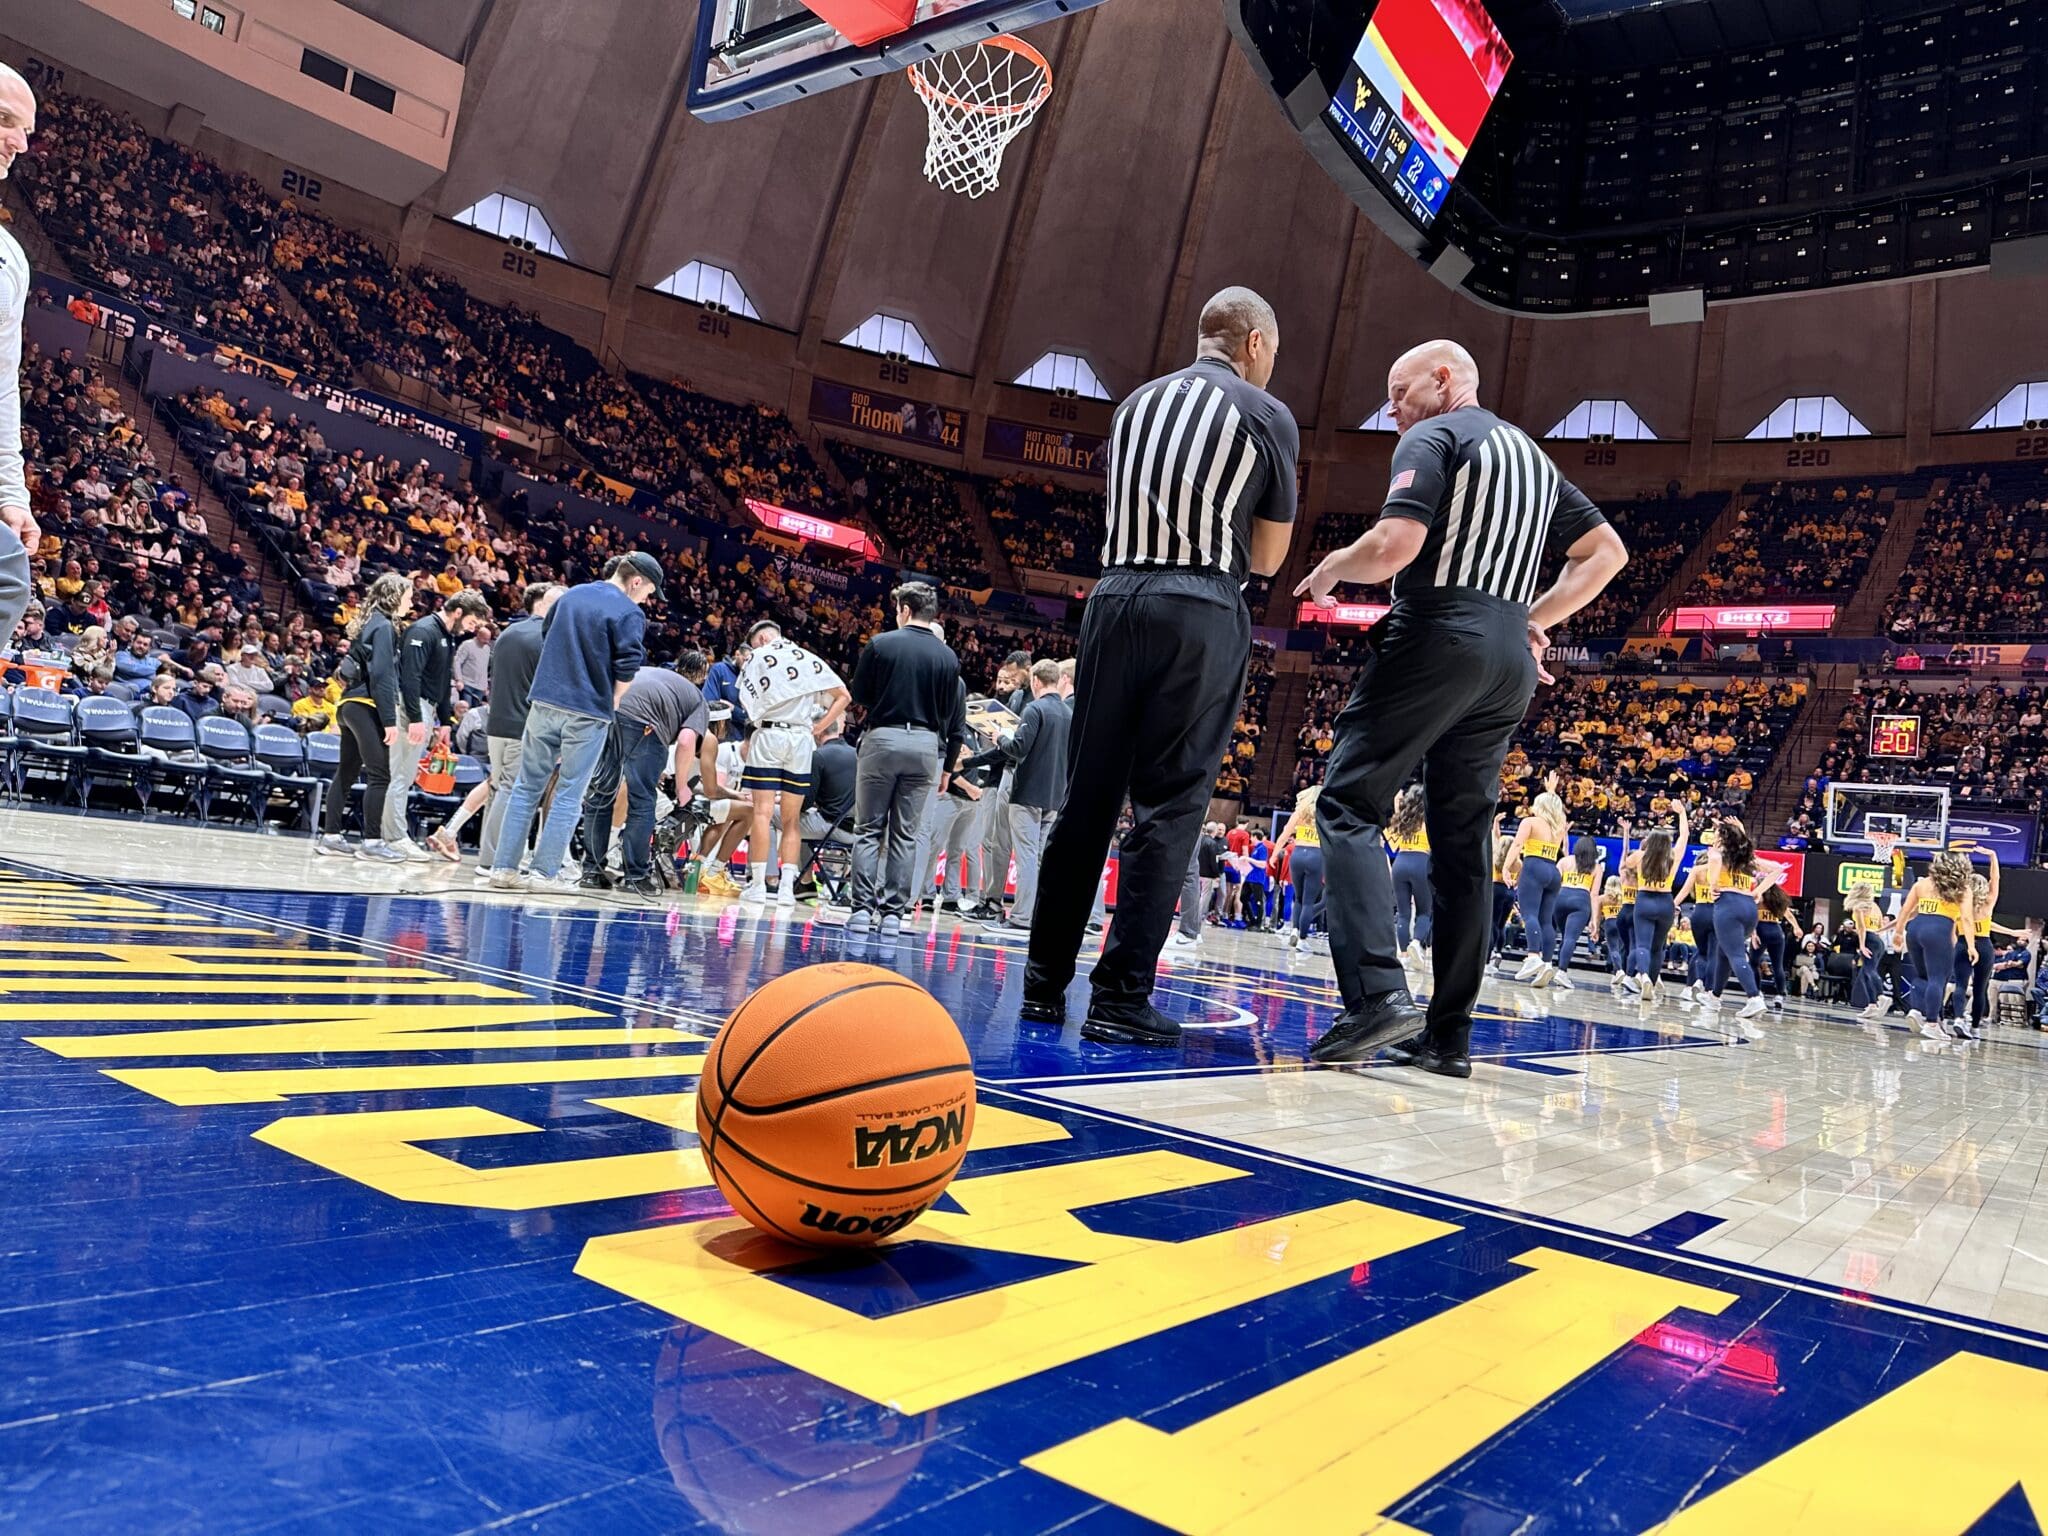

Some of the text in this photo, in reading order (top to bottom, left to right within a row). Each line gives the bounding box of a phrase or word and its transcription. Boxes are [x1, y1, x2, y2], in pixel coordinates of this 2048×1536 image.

[1369, 106, 1387, 137] 18
[1406, 155, 1425, 185] 22
[281, 169, 322, 201] 212
[502, 252, 538, 279] 213
[698, 314, 731, 339] 214
[879, 364, 910, 385] 215
[851, 391, 870, 407] ROD
[851, 404, 904, 434] THORN
[939, 425, 960, 448] 44
[1026, 430, 1062, 446] HOT ROD
[1023, 442, 1094, 470] HUNDLEY
[1584, 449, 1617, 466] 219
[1787, 449, 1830, 467] 220
[790, 562, 848, 585] MOUNTAINEER
[1340, 609, 1384, 620] SHEET
[1880, 732, 1909, 752] 20
[856, 1112, 894, 1121] BALL
[896, 1106, 931, 1118] GAME
[854, 1104, 967, 1170] NCAA
